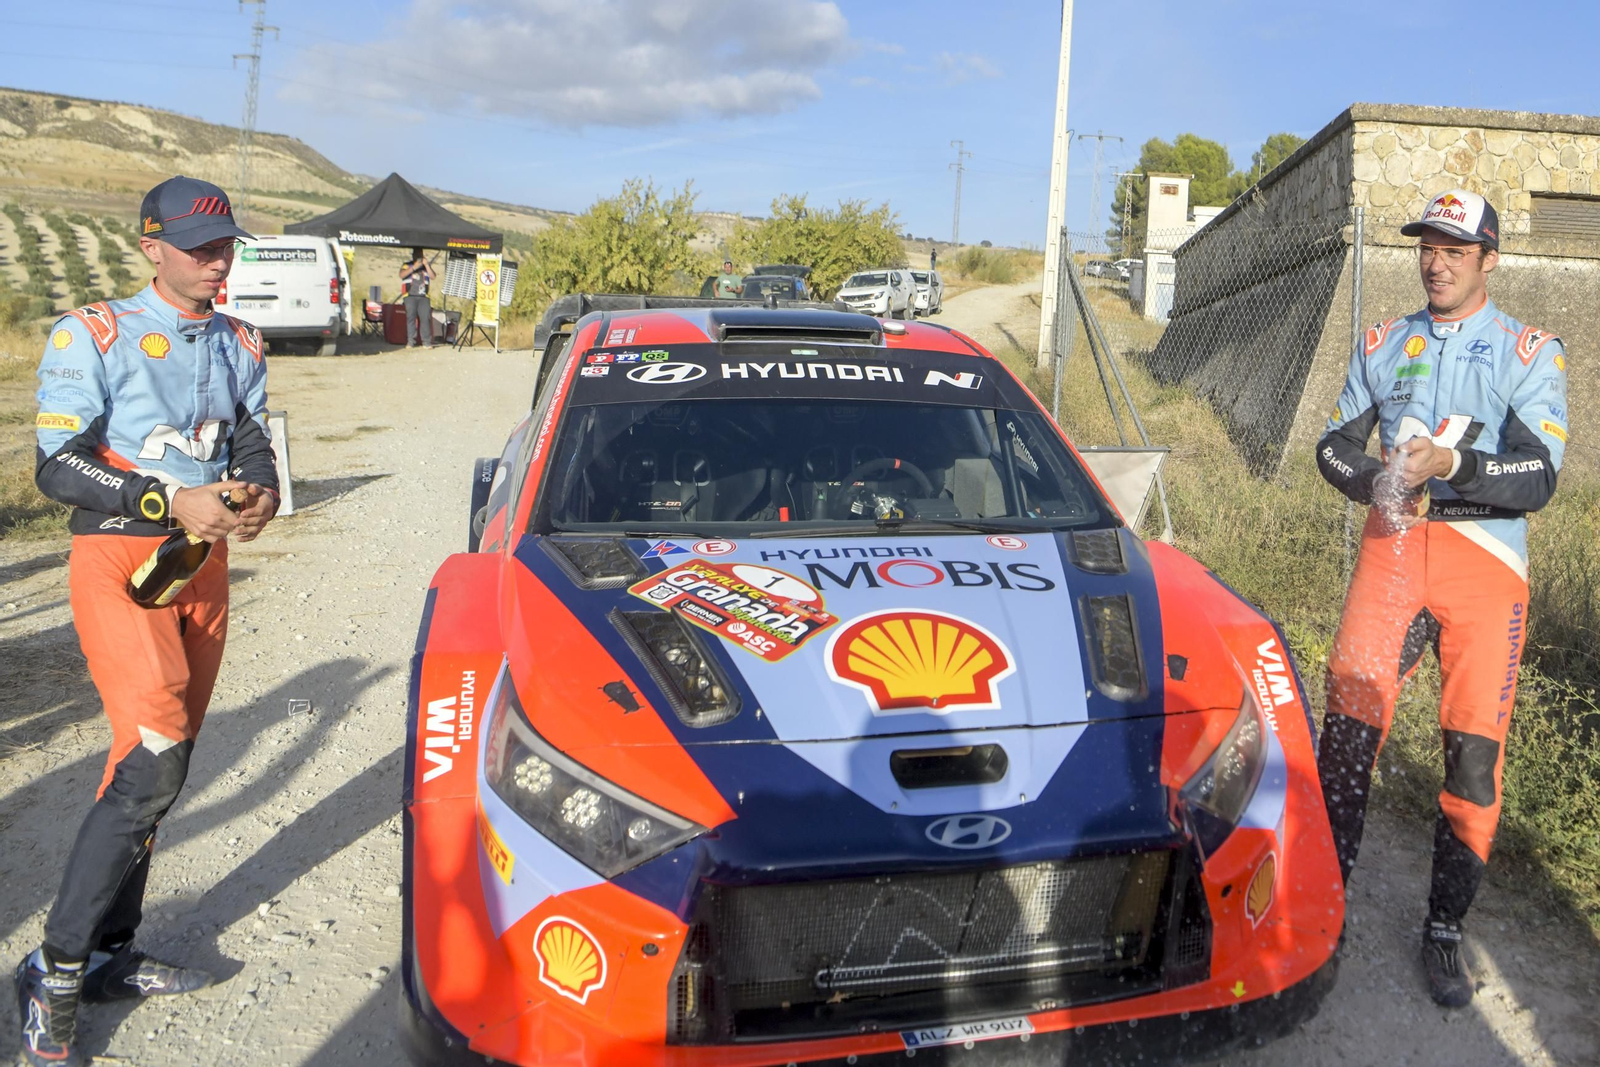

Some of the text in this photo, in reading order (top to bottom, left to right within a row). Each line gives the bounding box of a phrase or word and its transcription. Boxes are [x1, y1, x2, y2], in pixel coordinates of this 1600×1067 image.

[1425, 208, 1467, 223] Red Bull
[245, 249, 316, 260] enterprise
[1455, 355, 1494, 371] HYUNDAI
[722, 362, 903, 383] HYUNDAI
[69, 455, 125, 490] HYUNDA
[1502, 460, 1544, 475] HYUNDA
[1432, 506, 1492, 516] T. NEUVILLE
[705, 542, 723, 553] E
[1000, 536, 1017, 548] E
[760, 547, 934, 562] HYUNDAI
[764, 575, 786, 588] 1
[801, 559, 1056, 592] MOBIS
[697, 569, 769, 600] RALLYE
[760, 596, 780, 608] DE
[666, 570, 809, 641] Granada
[686, 603, 723, 624] BERNER
[738, 630, 776, 652] ASC
[458, 670, 476, 740] HYUNDAI
[1252, 669, 1279, 731] HYUNDAI
[962, 1022, 990, 1036] WR
[989, 1019, 1024, 1032] 907
